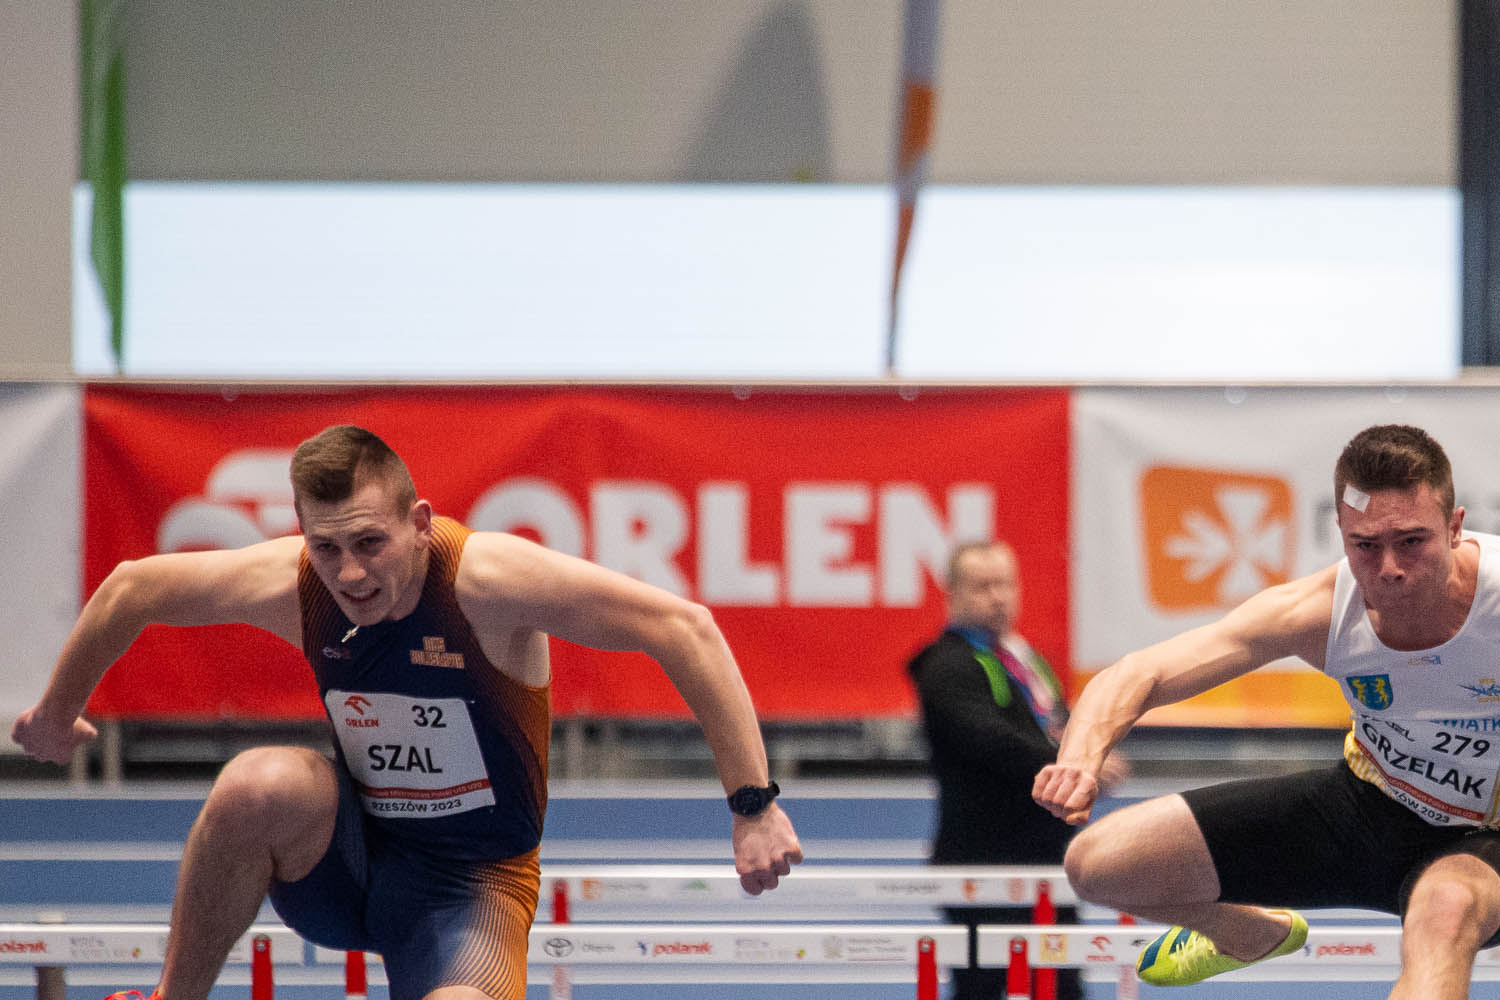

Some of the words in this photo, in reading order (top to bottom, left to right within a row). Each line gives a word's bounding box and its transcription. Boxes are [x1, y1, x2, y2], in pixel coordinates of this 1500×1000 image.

[411, 704, 447, 729] 32
[1431, 731, 1491, 758] 279
[367, 744, 443, 774] SZAL
[1361, 721, 1487, 799] GRZELAK
[372, 797, 428, 812] RZESZÓW
[430, 798, 462, 812] 2023
[1420, 807, 1450, 824] 2023
